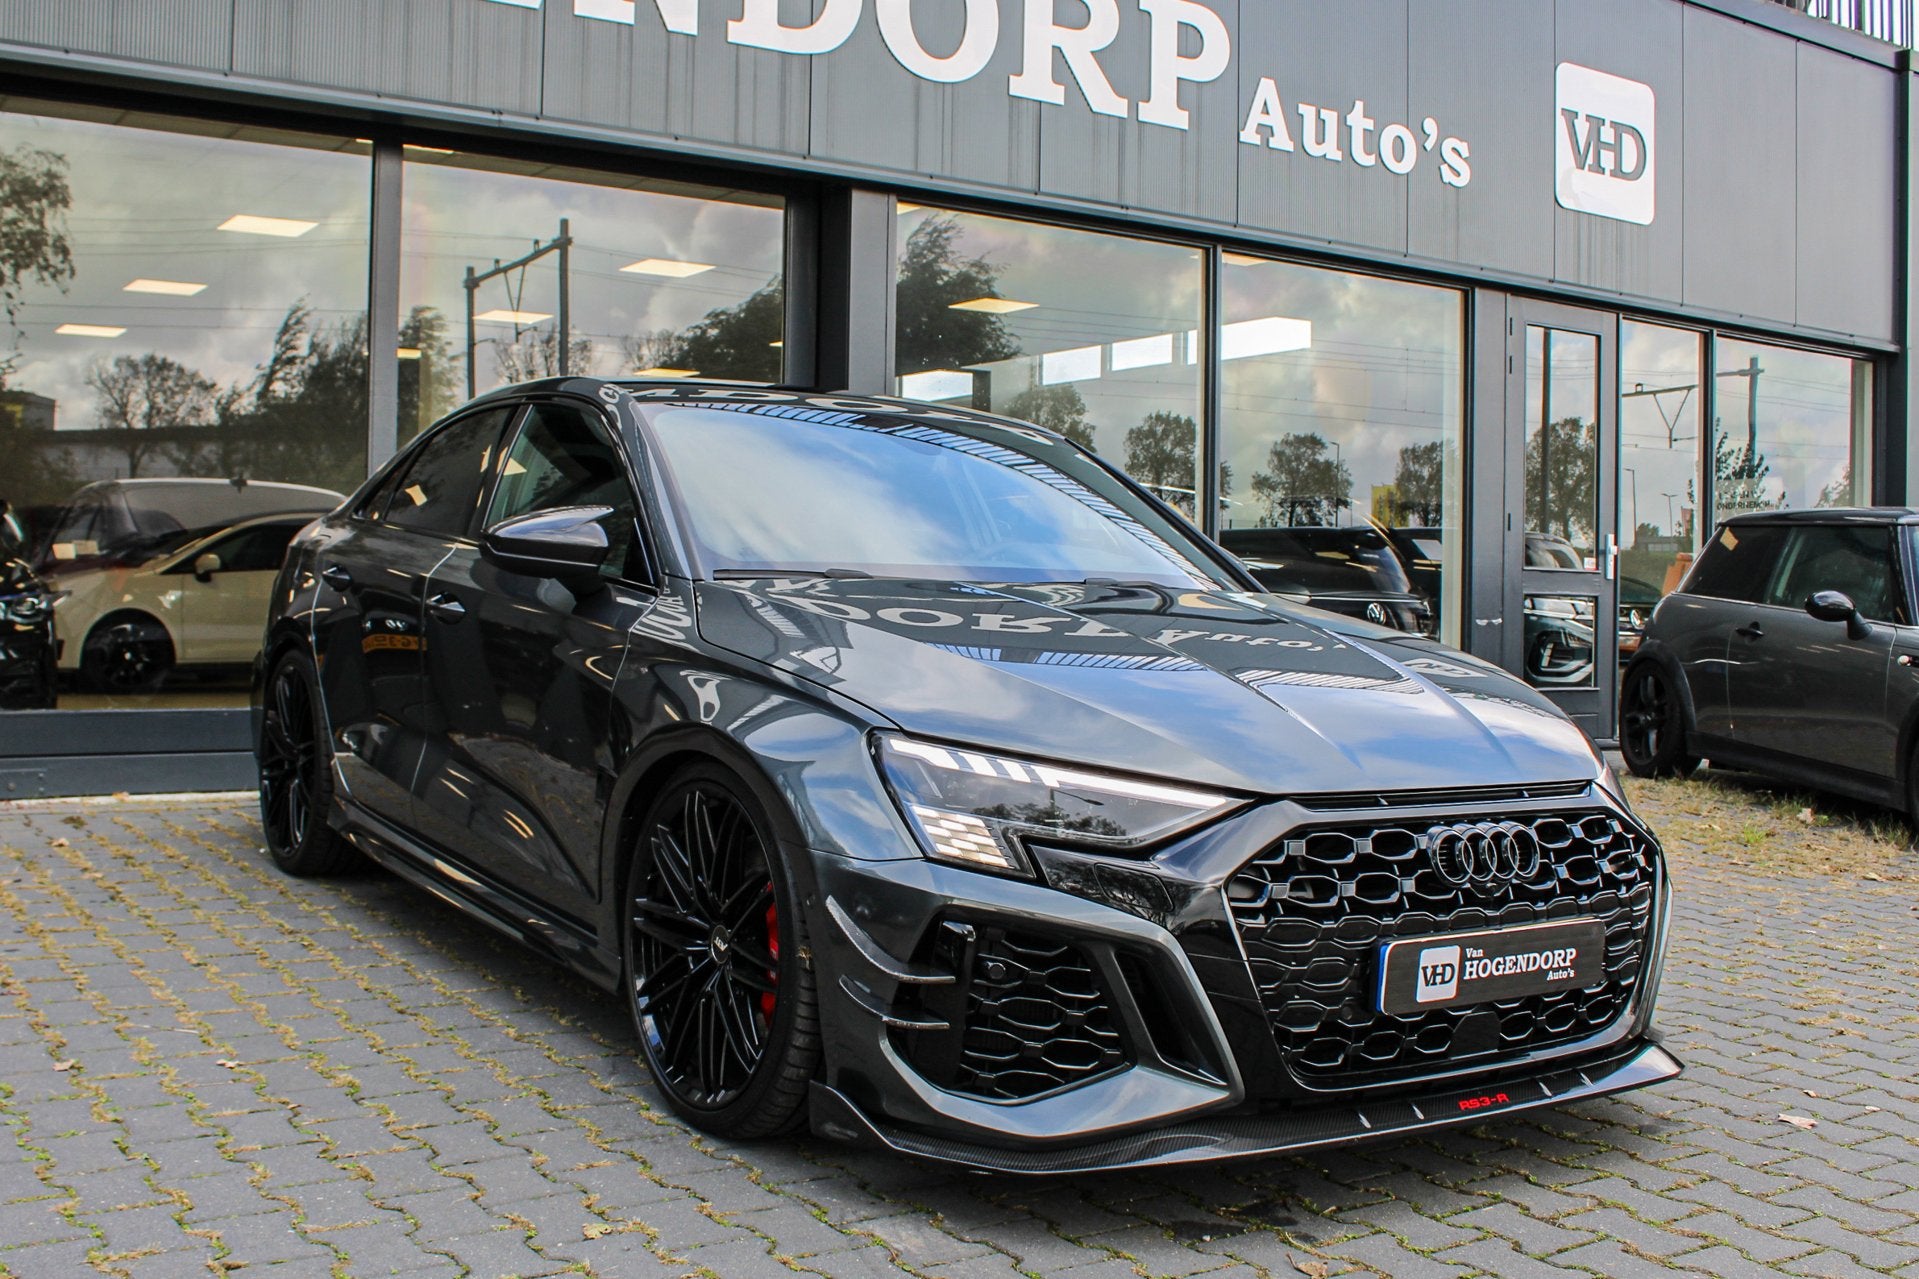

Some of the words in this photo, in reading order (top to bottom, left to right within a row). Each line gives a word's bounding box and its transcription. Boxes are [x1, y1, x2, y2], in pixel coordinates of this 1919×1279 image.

[1239, 77, 1471, 188] Auto's
[1560, 107, 1647, 182] VHD
[1463, 947, 1577, 980] HOGENDORP
[1465, 947, 1484, 958] Van
[1421, 962, 1456, 987] VHD
[1546, 967, 1575, 981] Auto's
[1458, 1092, 1510, 1111] RS3-R
